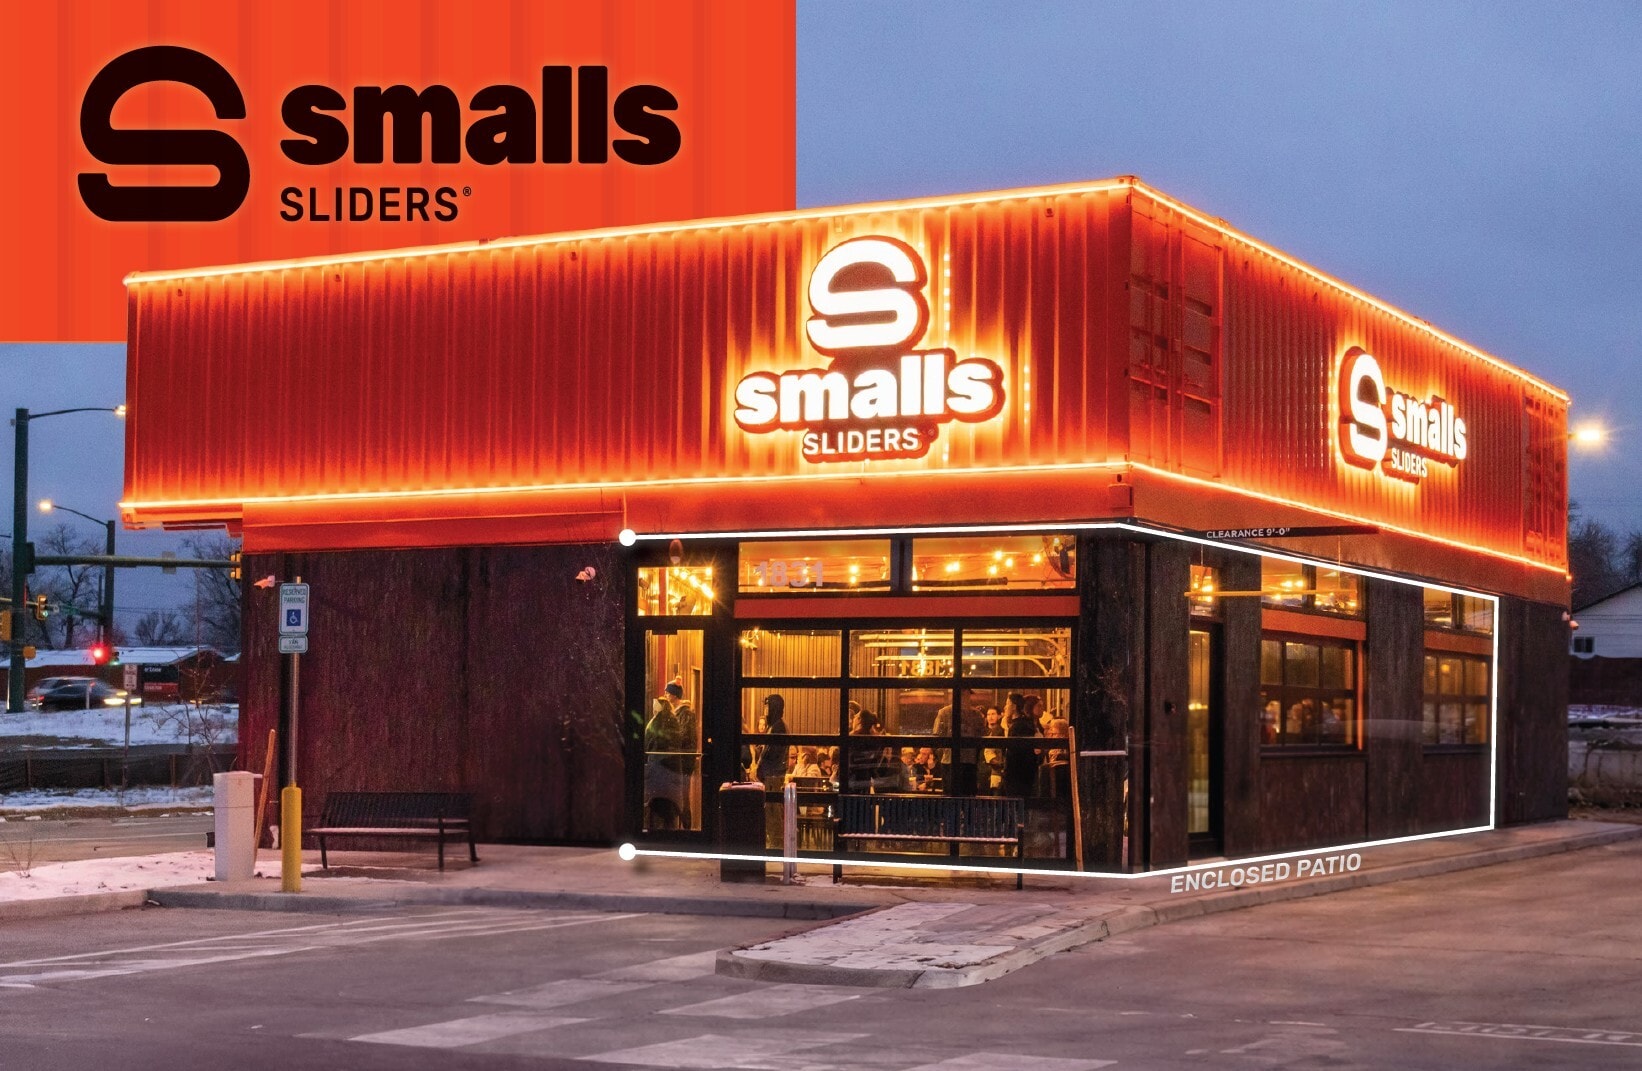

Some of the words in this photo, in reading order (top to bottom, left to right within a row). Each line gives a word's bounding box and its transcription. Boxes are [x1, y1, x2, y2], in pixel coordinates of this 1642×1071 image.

[734, 353, 995, 425] smalls
[1391, 393, 1467, 460] smalls
[803, 427, 920, 456] SLIDERS
[1391, 447, 1428, 478] SLIDERS
[1206, 528, 1264, 540] CLEARANCE
[756, 561, 823, 588] 1831
[283, 596, 305, 604] PARKING
